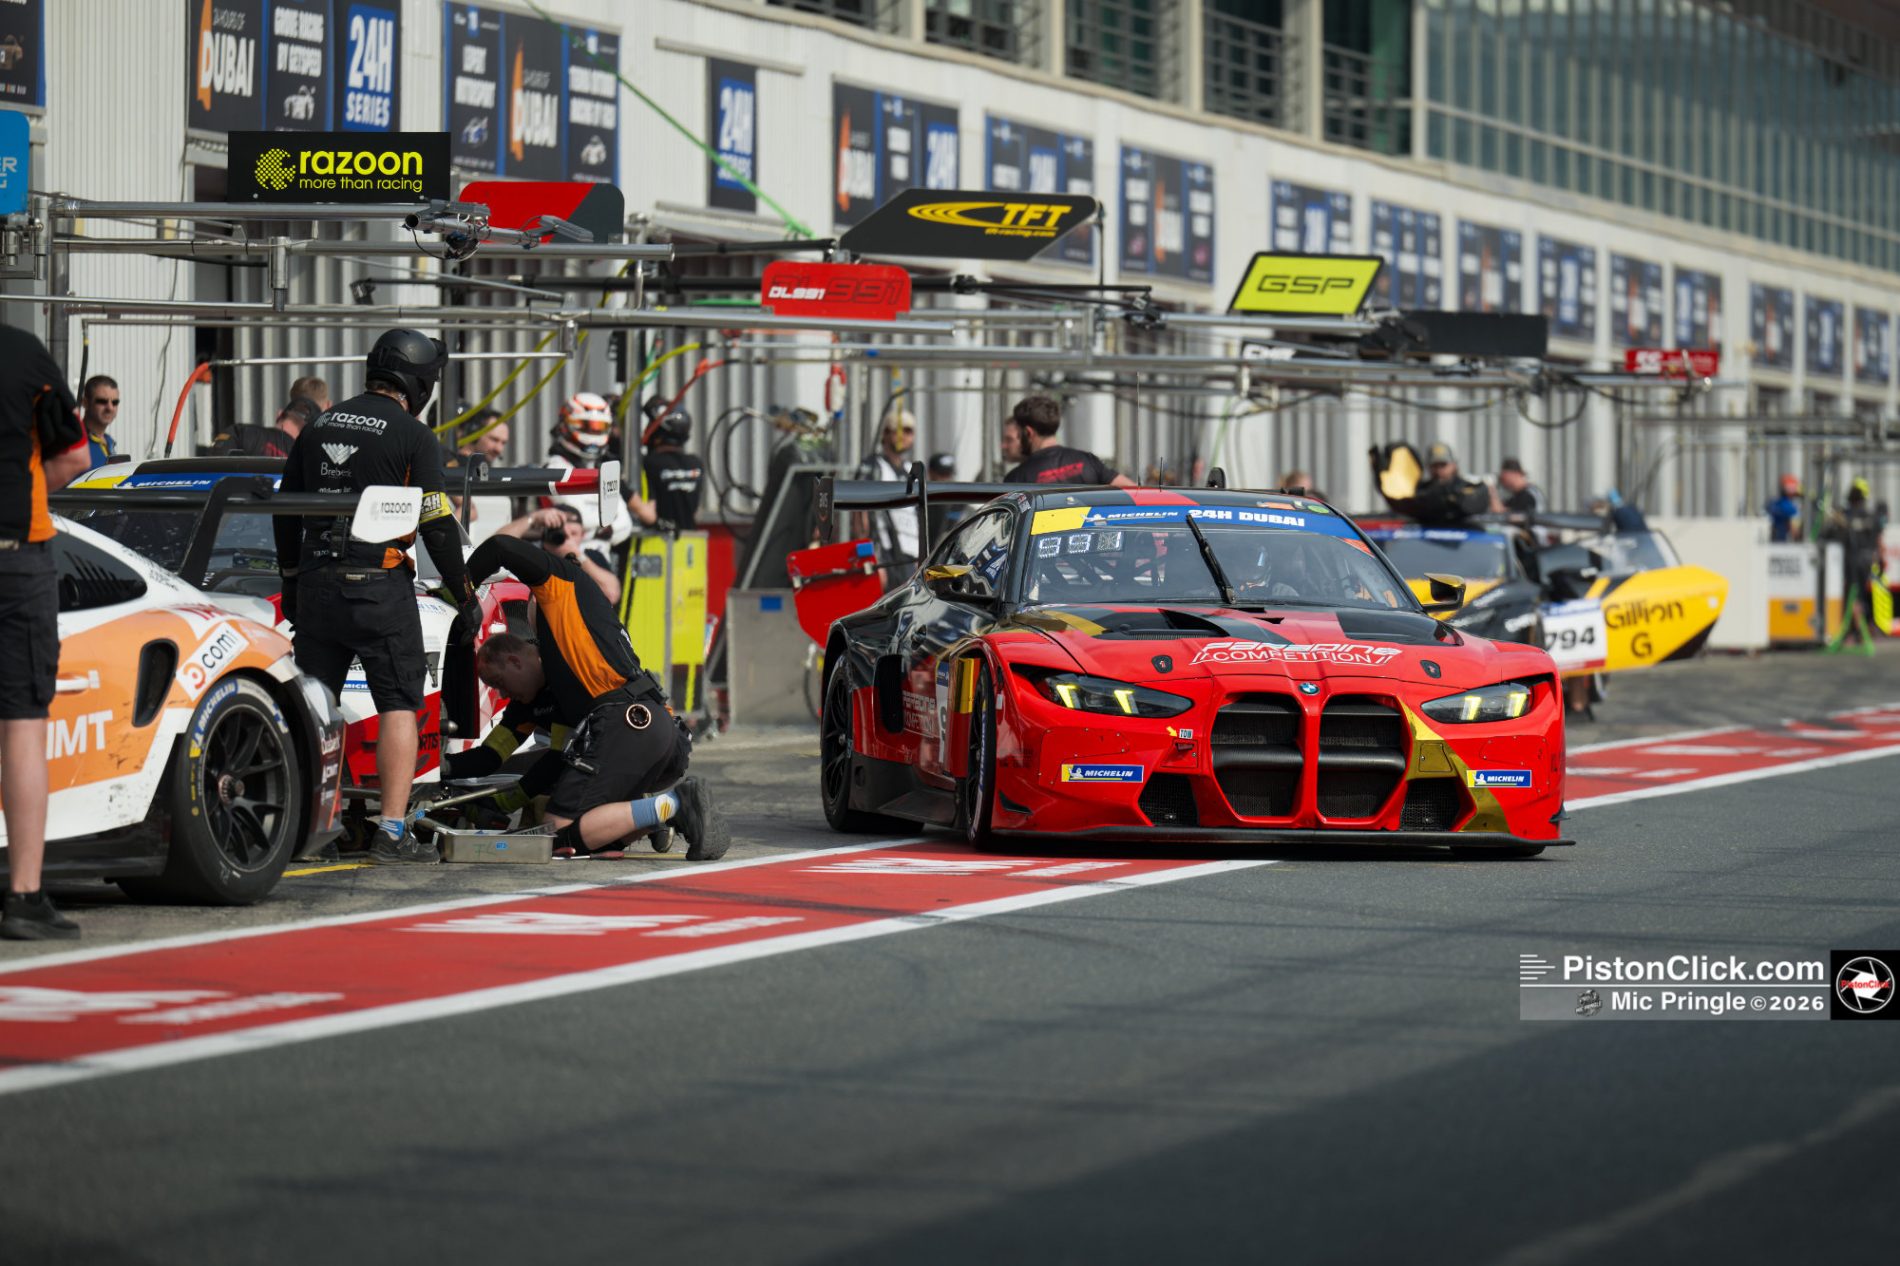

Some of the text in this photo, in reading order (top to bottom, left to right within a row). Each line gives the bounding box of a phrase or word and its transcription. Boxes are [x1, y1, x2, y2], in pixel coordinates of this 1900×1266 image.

[201, 30, 255, 97] DUBAI
[348, 14, 393, 93] 24H
[345, 91, 390, 127] SERIES
[513, 88, 558, 148] DUBAI
[300, 150, 423, 175] razoon
[300, 177, 423, 192] more than racing
[1001, 203, 1072, 227] TFT
[1256, 274, 1355, 296] GSP
[330, 411, 388, 430] razoon
[346, 422, 362, 431] than
[362, 424, 384, 436] racing
[136, 479, 212, 488] MICHELIN
[380, 501, 412, 514] razoon
[1107, 511, 1179, 520] MICHELIN
[1188, 509, 1305, 527] 24H DUBAI
[1545, 626, 1597, 651] 794
[1213, 650, 1371, 664] COMPETITION
[200, 681, 237, 731] MICHELIN
[1084, 769, 1134, 777] MICHELIN
